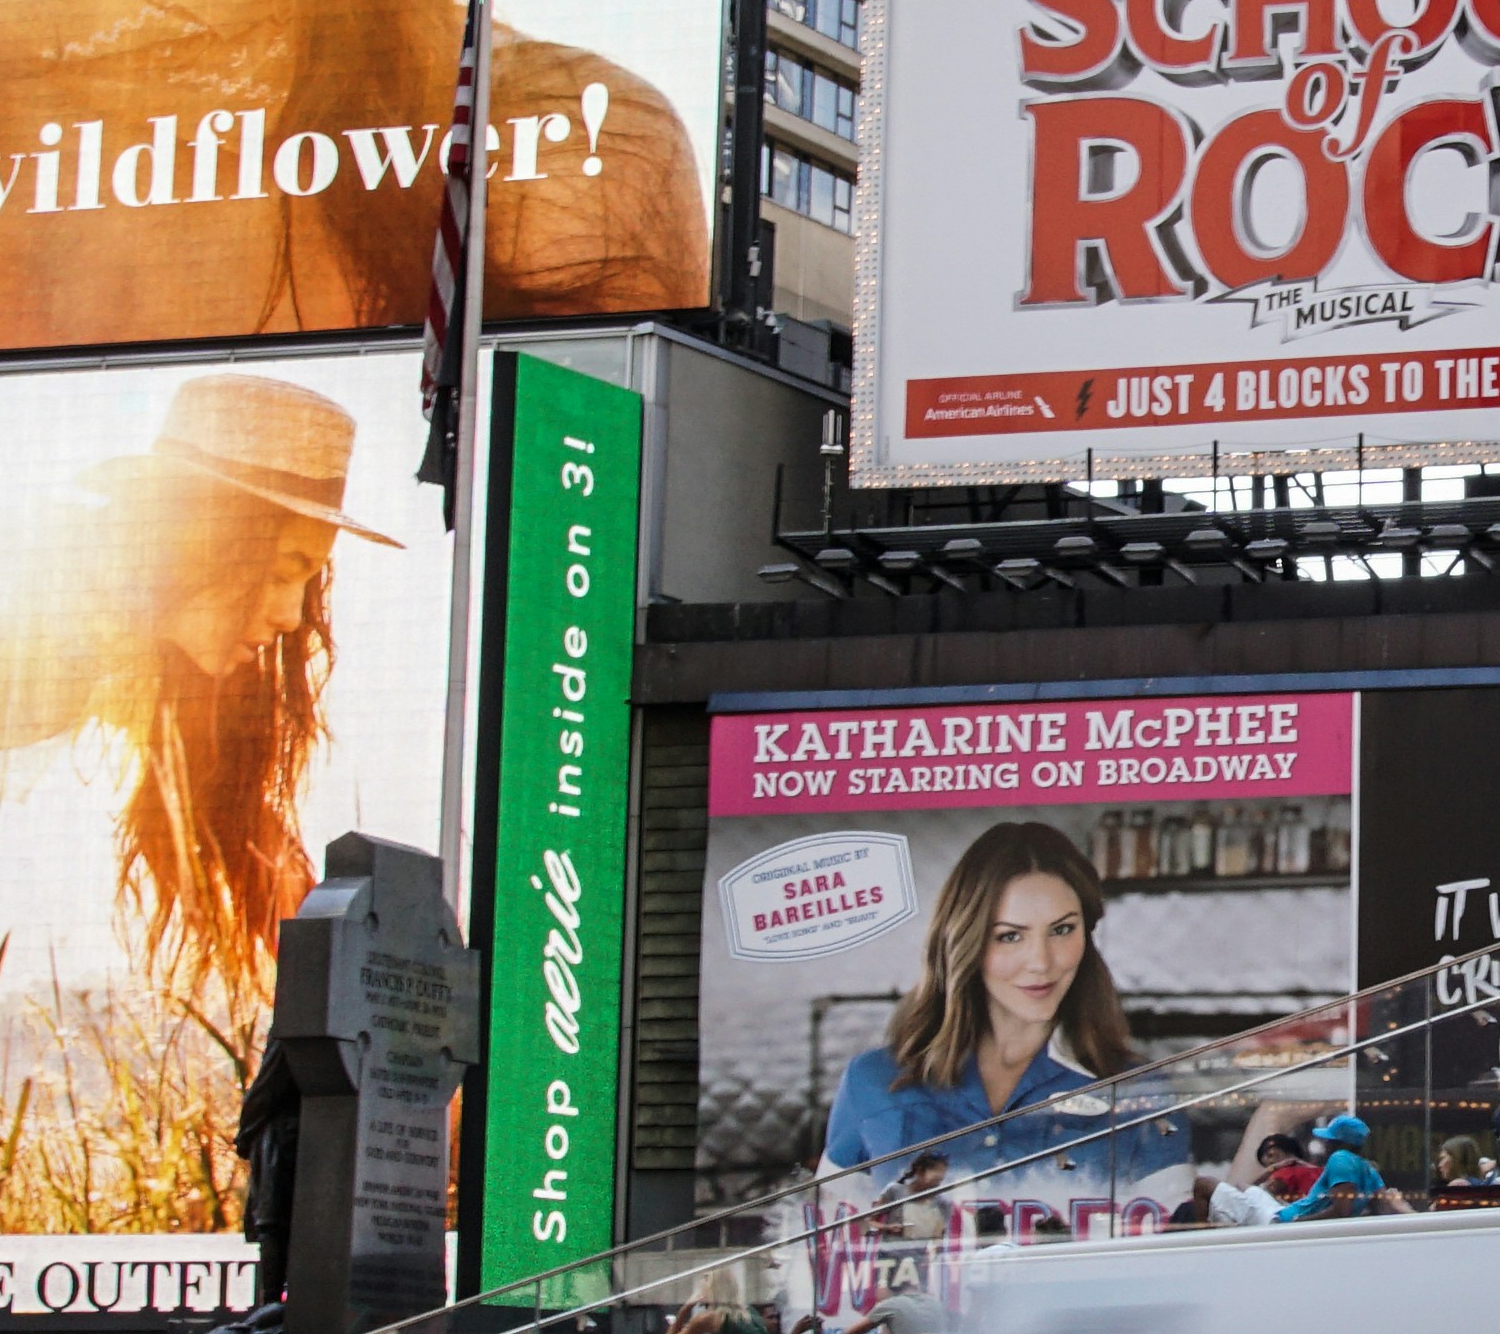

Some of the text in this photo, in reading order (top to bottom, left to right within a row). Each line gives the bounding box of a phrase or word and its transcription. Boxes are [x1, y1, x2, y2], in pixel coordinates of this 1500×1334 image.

[1282, 28, 1420, 159] of
[1265, 287, 1302, 312] THE
[1296, 291, 1414, 330] MUSICAL
[1107, 373, 1193, 421] JUST
[1202, 370, 1226, 415] 4
[1235, 362, 1370, 412] BLOCKS
[1379, 360, 1424, 402] TO
[1433, 354, 1499, 400] THE
[753, 711, 1068, 764] KATHARINE
[752, 753, 1298, 799] NOW STARRING ON BROADWAY
[531, 435, 596, 1242] Shop aerie inside on 3!
[752, 886, 884, 932] BAREILLES
[783, 871, 846, 900] SARA
[1433, 878, 1490, 941] IT
